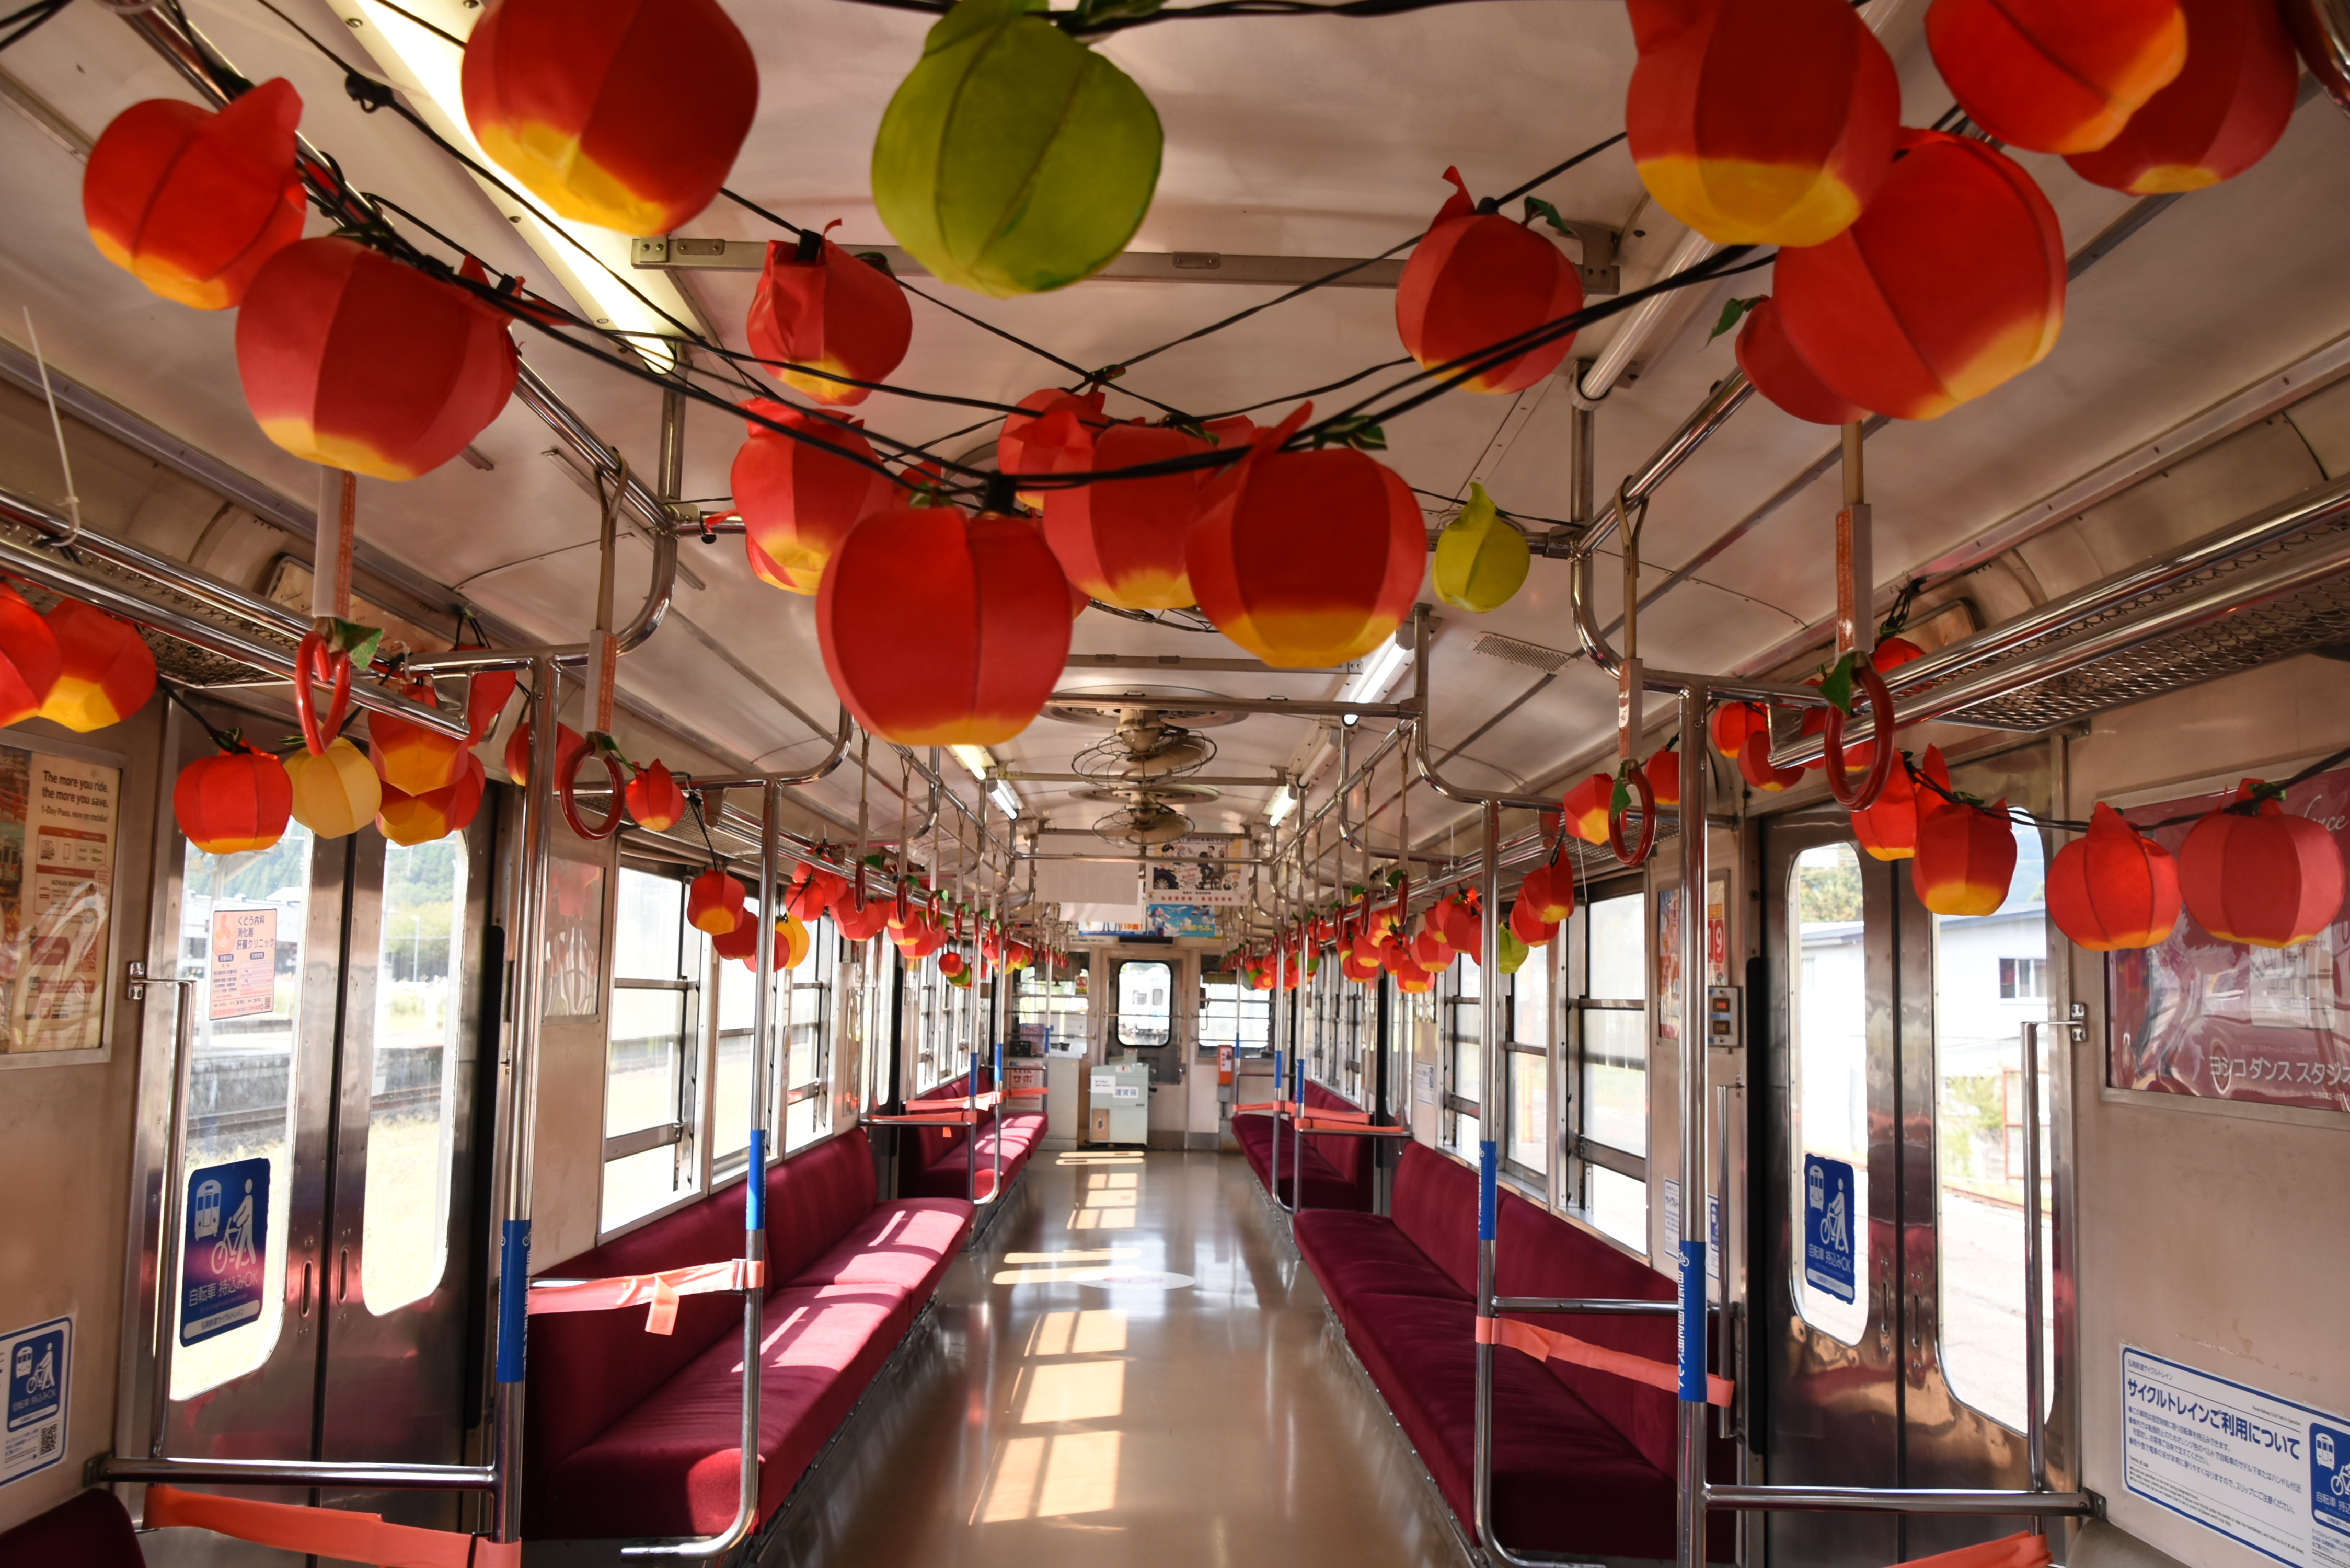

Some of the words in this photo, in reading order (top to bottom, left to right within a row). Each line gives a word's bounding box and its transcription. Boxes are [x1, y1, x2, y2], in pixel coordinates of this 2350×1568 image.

[43, 770, 57, 783] The
[59, 776, 78, 787] more
[79, 780, 93, 790] you
[94, 780, 109, 793] ride,
[42, 786, 54, 799] the
[56, 791, 75, 802] more
[77, 795, 90, 805] you
[91, 798, 108, 808] save.
[41, 805, 57, 816] 1-Day
[238, 915, 265, 926] くどう内科
[237, 927, 254, 938] 消化器
[236, 938, 274, 950] 肝臓クリニック
[2209, 1056, 2247, 1077] ヨシコ
[2249, 1057, 2293, 1082] ダンス
[189, 1283, 217, 1307] 自転車
[218, 1269, 259, 1297] 持込みOK
[2128, 1378, 2300, 1460] サイクルトレインご利用について
[2129, 1455, 2138, 1463] Terms
[2316, 1491, 2336, 1507] 自転車
